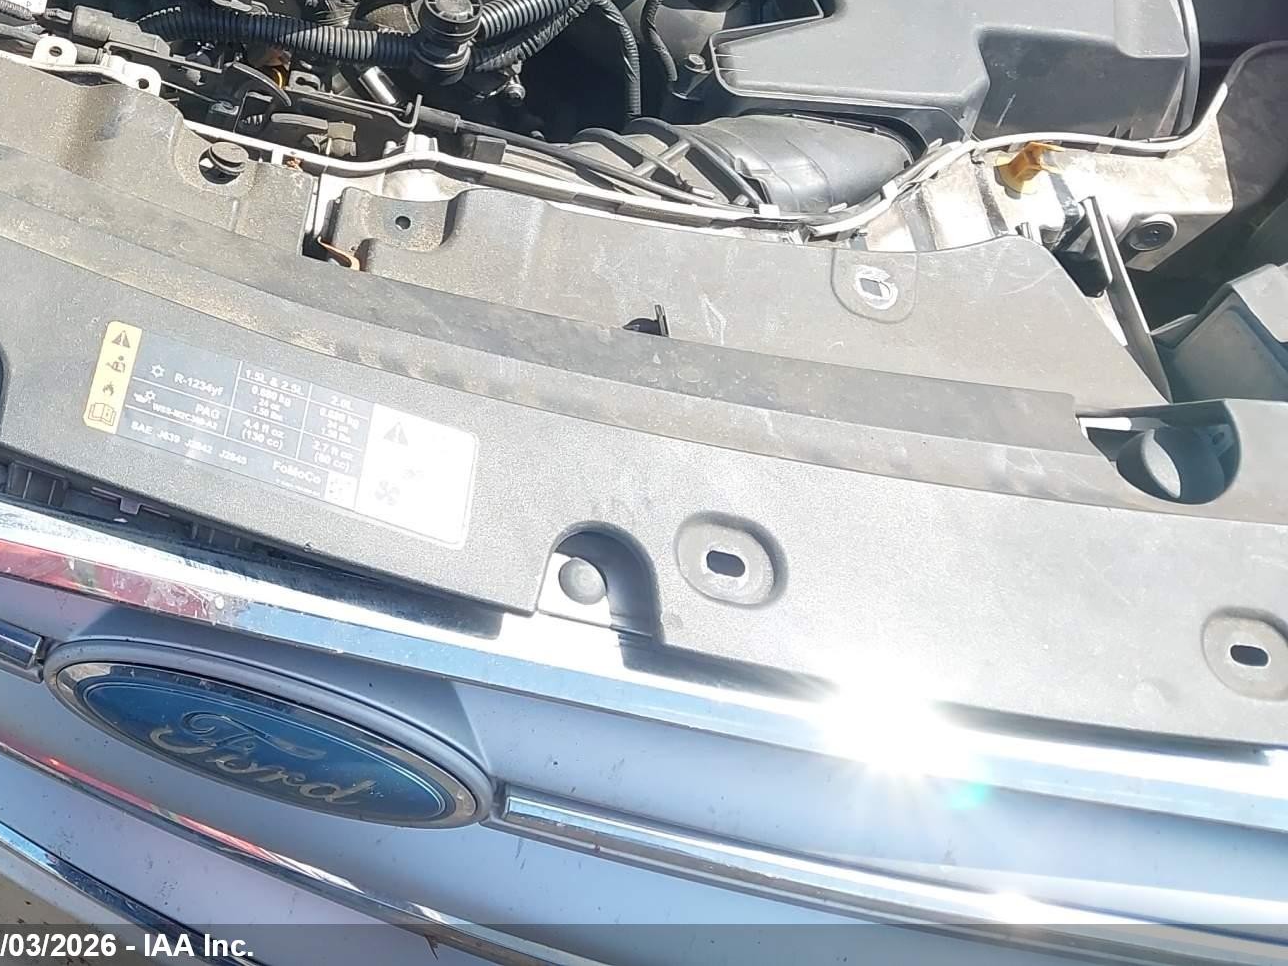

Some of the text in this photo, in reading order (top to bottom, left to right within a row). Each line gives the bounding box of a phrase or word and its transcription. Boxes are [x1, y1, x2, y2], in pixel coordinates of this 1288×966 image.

[174, 372, 225, 398] R-1234yf
[194, 403, 221, 420] PAG
[130, 420, 154, 435] SAE
[273, 460, 322, 485] FoMoCo
[148, 710, 377, 806] Ford
